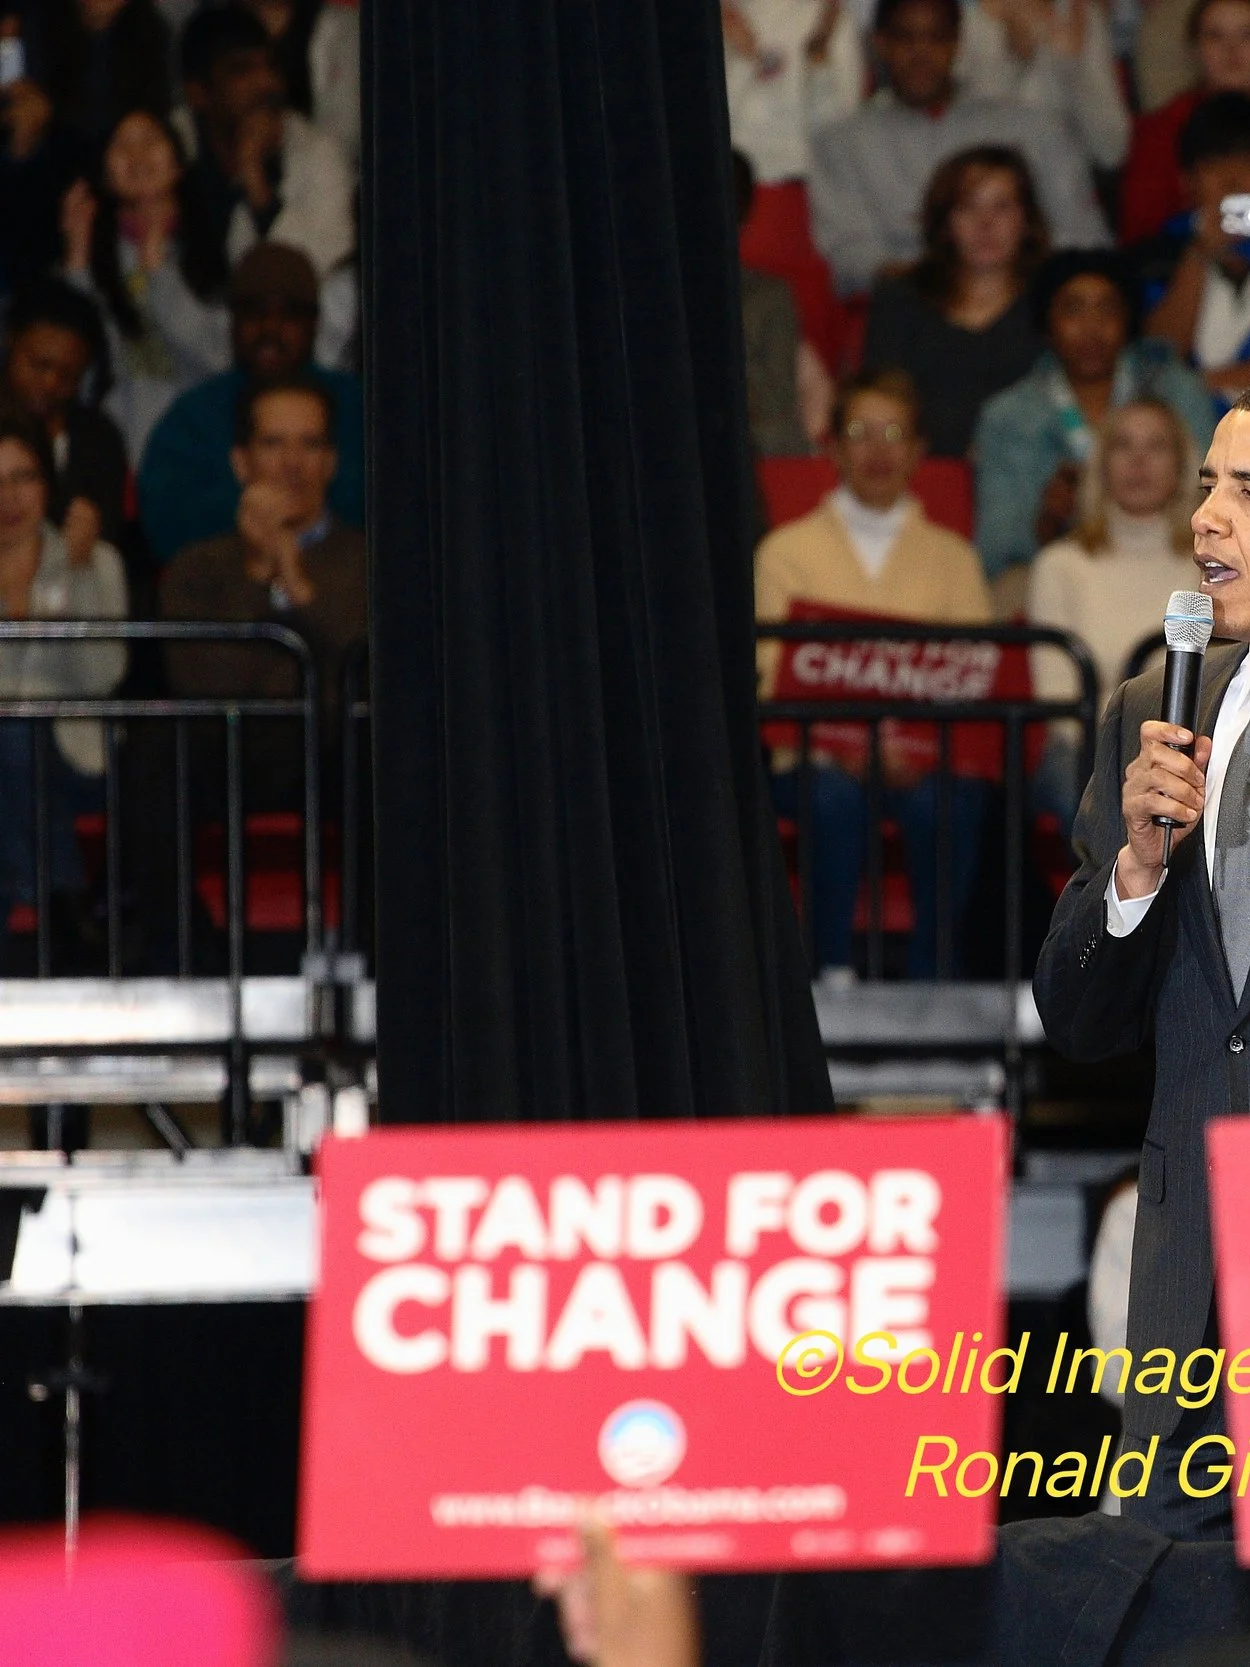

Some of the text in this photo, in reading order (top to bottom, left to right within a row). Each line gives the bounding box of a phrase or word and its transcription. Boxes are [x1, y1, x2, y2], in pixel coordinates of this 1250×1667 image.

[357, 1170, 943, 1262] STAND FOR
[352, 1257, 938, 1374] CHANGE
